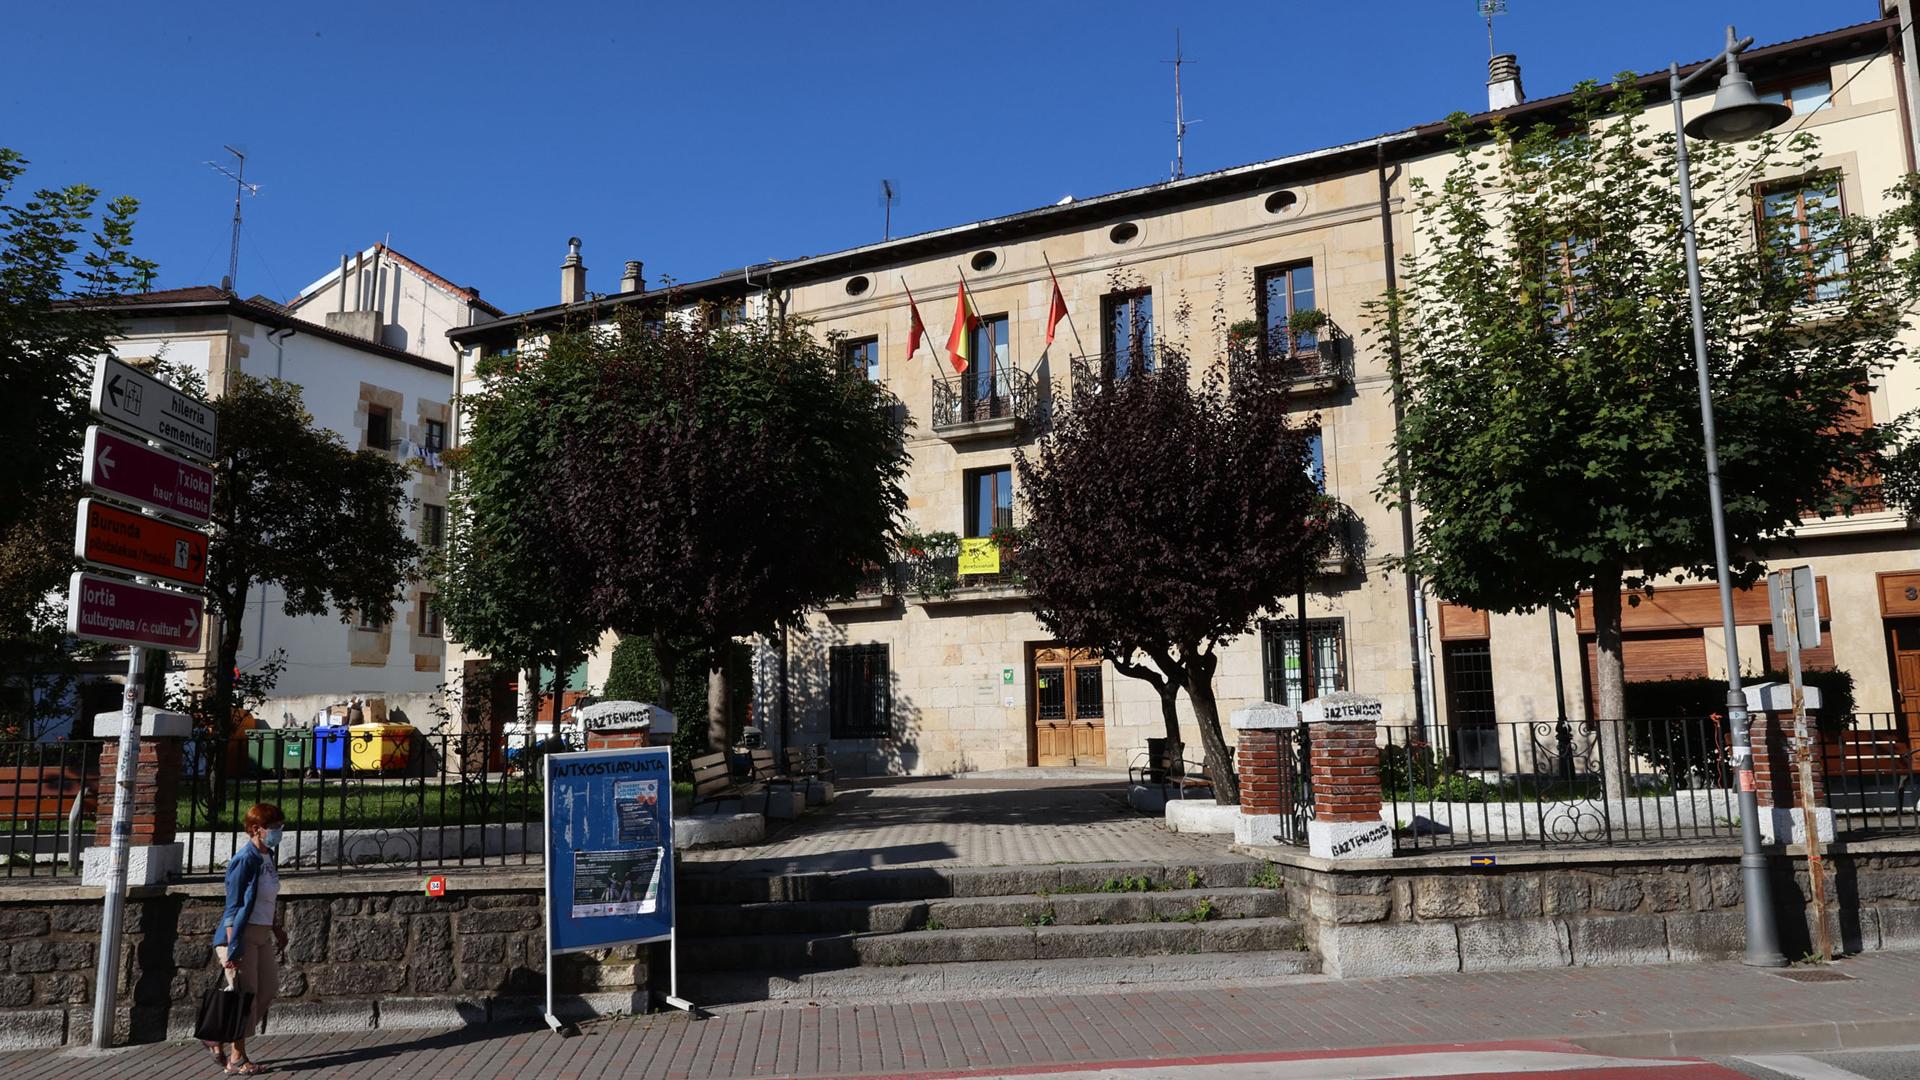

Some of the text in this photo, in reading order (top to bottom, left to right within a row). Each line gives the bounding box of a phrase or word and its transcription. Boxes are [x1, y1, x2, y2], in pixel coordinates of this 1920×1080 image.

[171, 395, 205, 425] hilerria
[158, 420, 212, 454] cementerio
[178, 469, 210, 494] Txioka
[176, 491, 208, 513] ikastola
[91, 511, 141, 539] Burunda
[81, 609, 135, 631] kulturgunea
[150, 622, 182, 638] cultural
